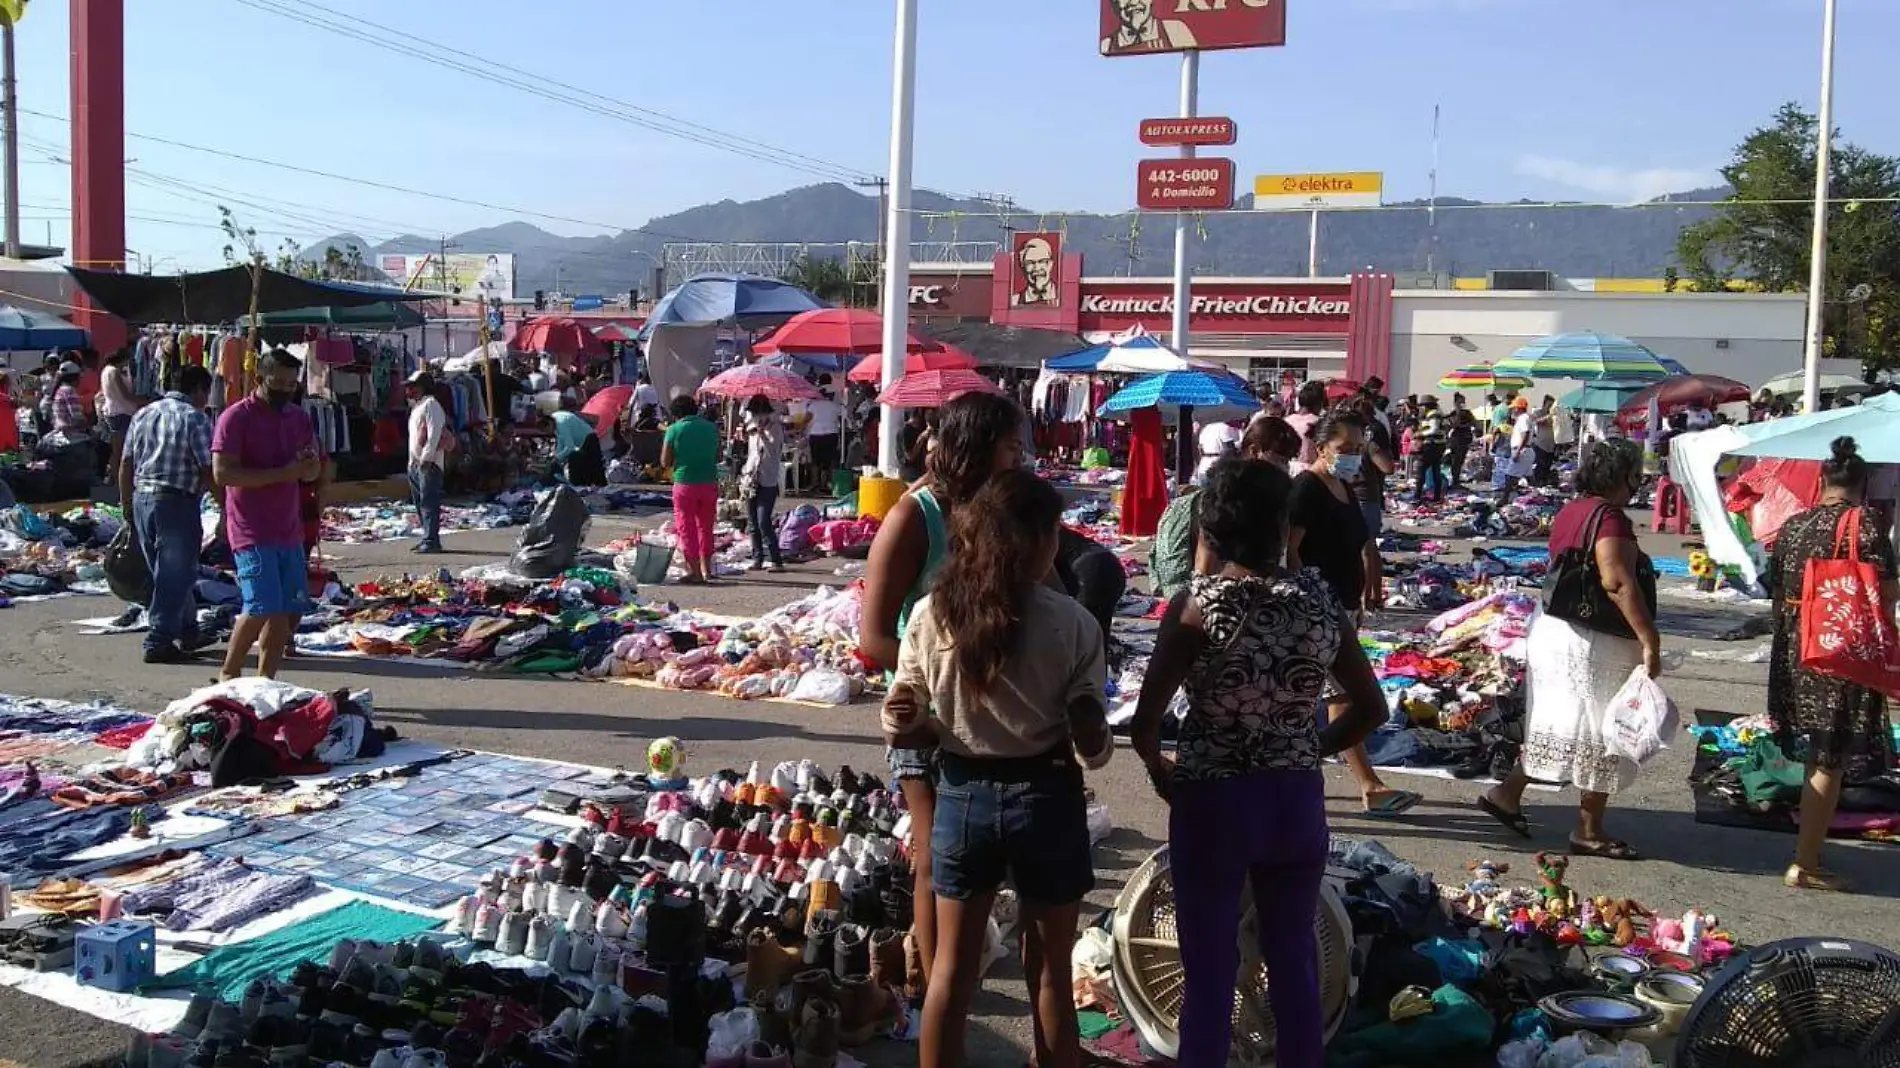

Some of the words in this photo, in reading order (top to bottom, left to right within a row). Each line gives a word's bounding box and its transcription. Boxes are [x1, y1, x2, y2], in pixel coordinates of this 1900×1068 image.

[1144, 124, 1227, 136] AUTOEXPRESS
[1148, 168, 1220, 183] 442-6000
[1300, 176, 1353, 191] elektra
[1151, 187, 1160, 199] A
[1163, 184, 1217, 198] Domicilio
[908, 285, 942, 304] FC
[1081, 294, 1174, 312] Kentuck
